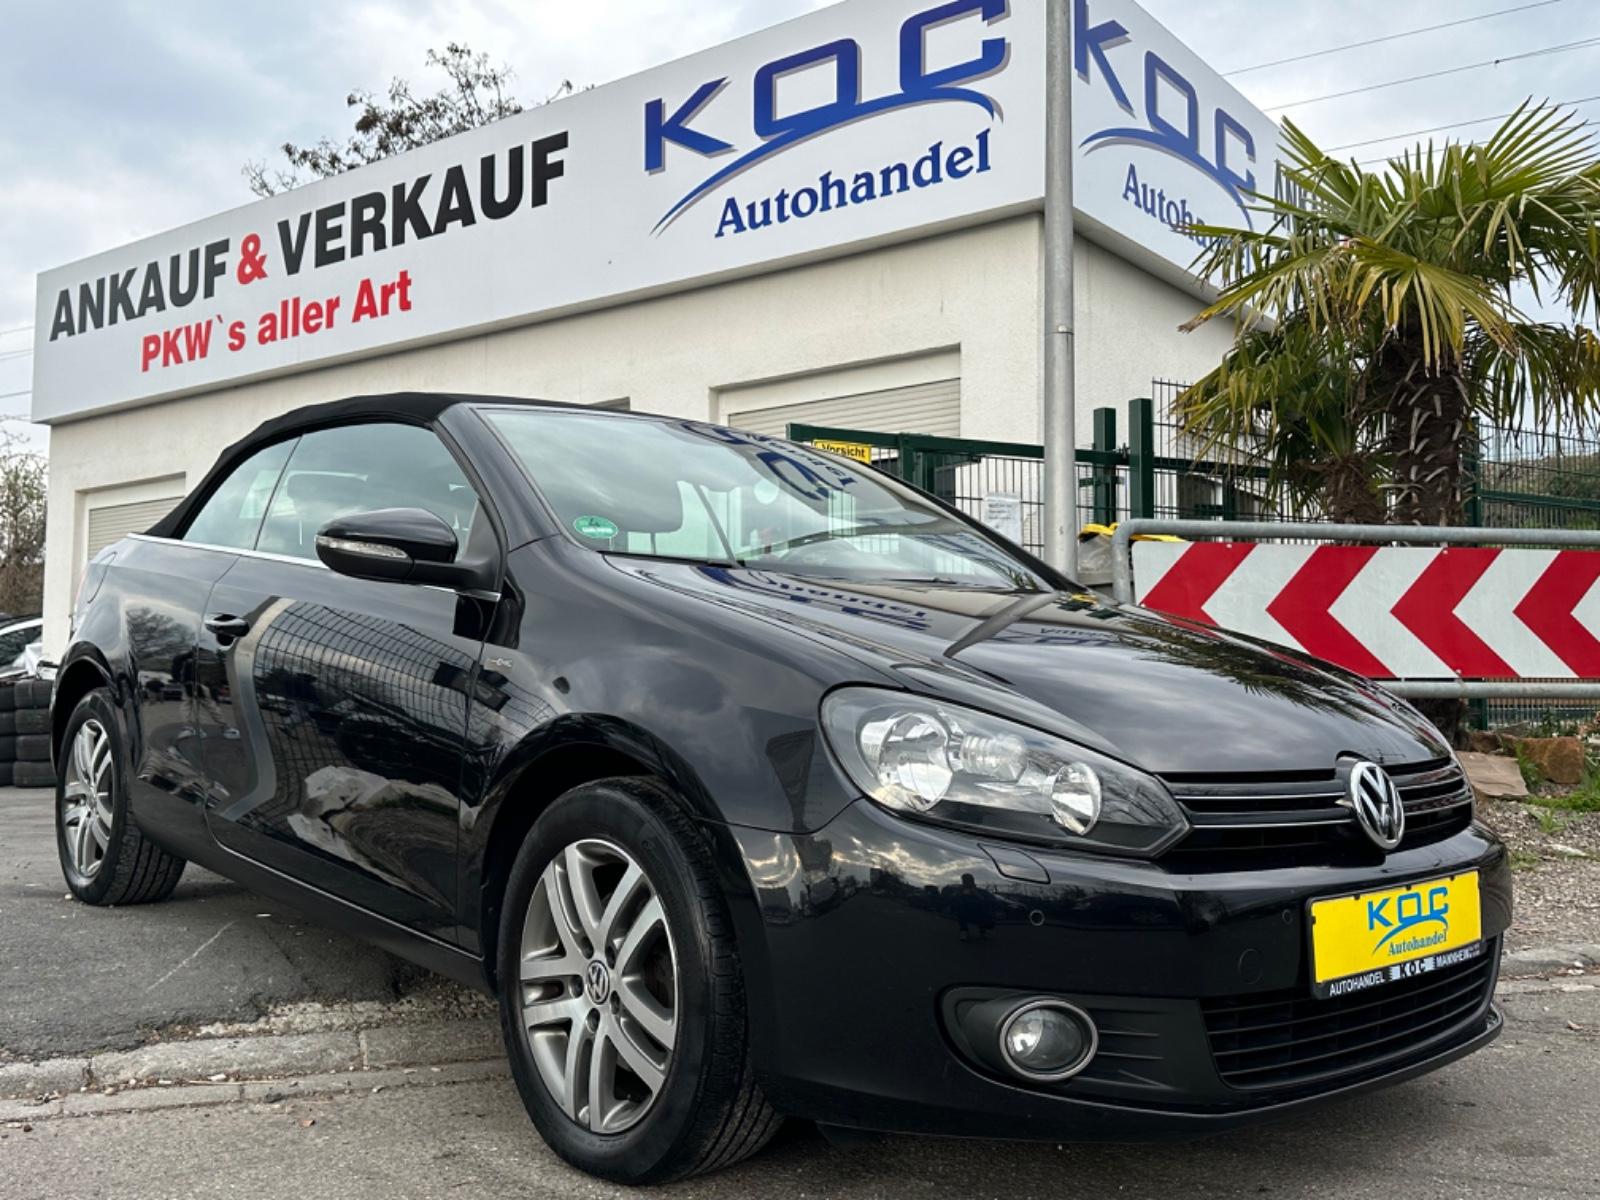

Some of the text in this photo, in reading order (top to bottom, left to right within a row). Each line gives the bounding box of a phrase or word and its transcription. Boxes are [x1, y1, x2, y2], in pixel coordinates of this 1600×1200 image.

[644, 0, 1011, 175] KOC
[714, 128, 992, 239] Autohandel
[49, 131, 569, 342] ANKAUF & VERKAUF
[257, 297, 340, 346] aller
[352, 269, 412, 323] Art
[1367, 886, 1449, 931] KOC
[1388, 929, 1448, 956] Autohandel
[1329, 971, 1384, 996] AUTOHANDEL
